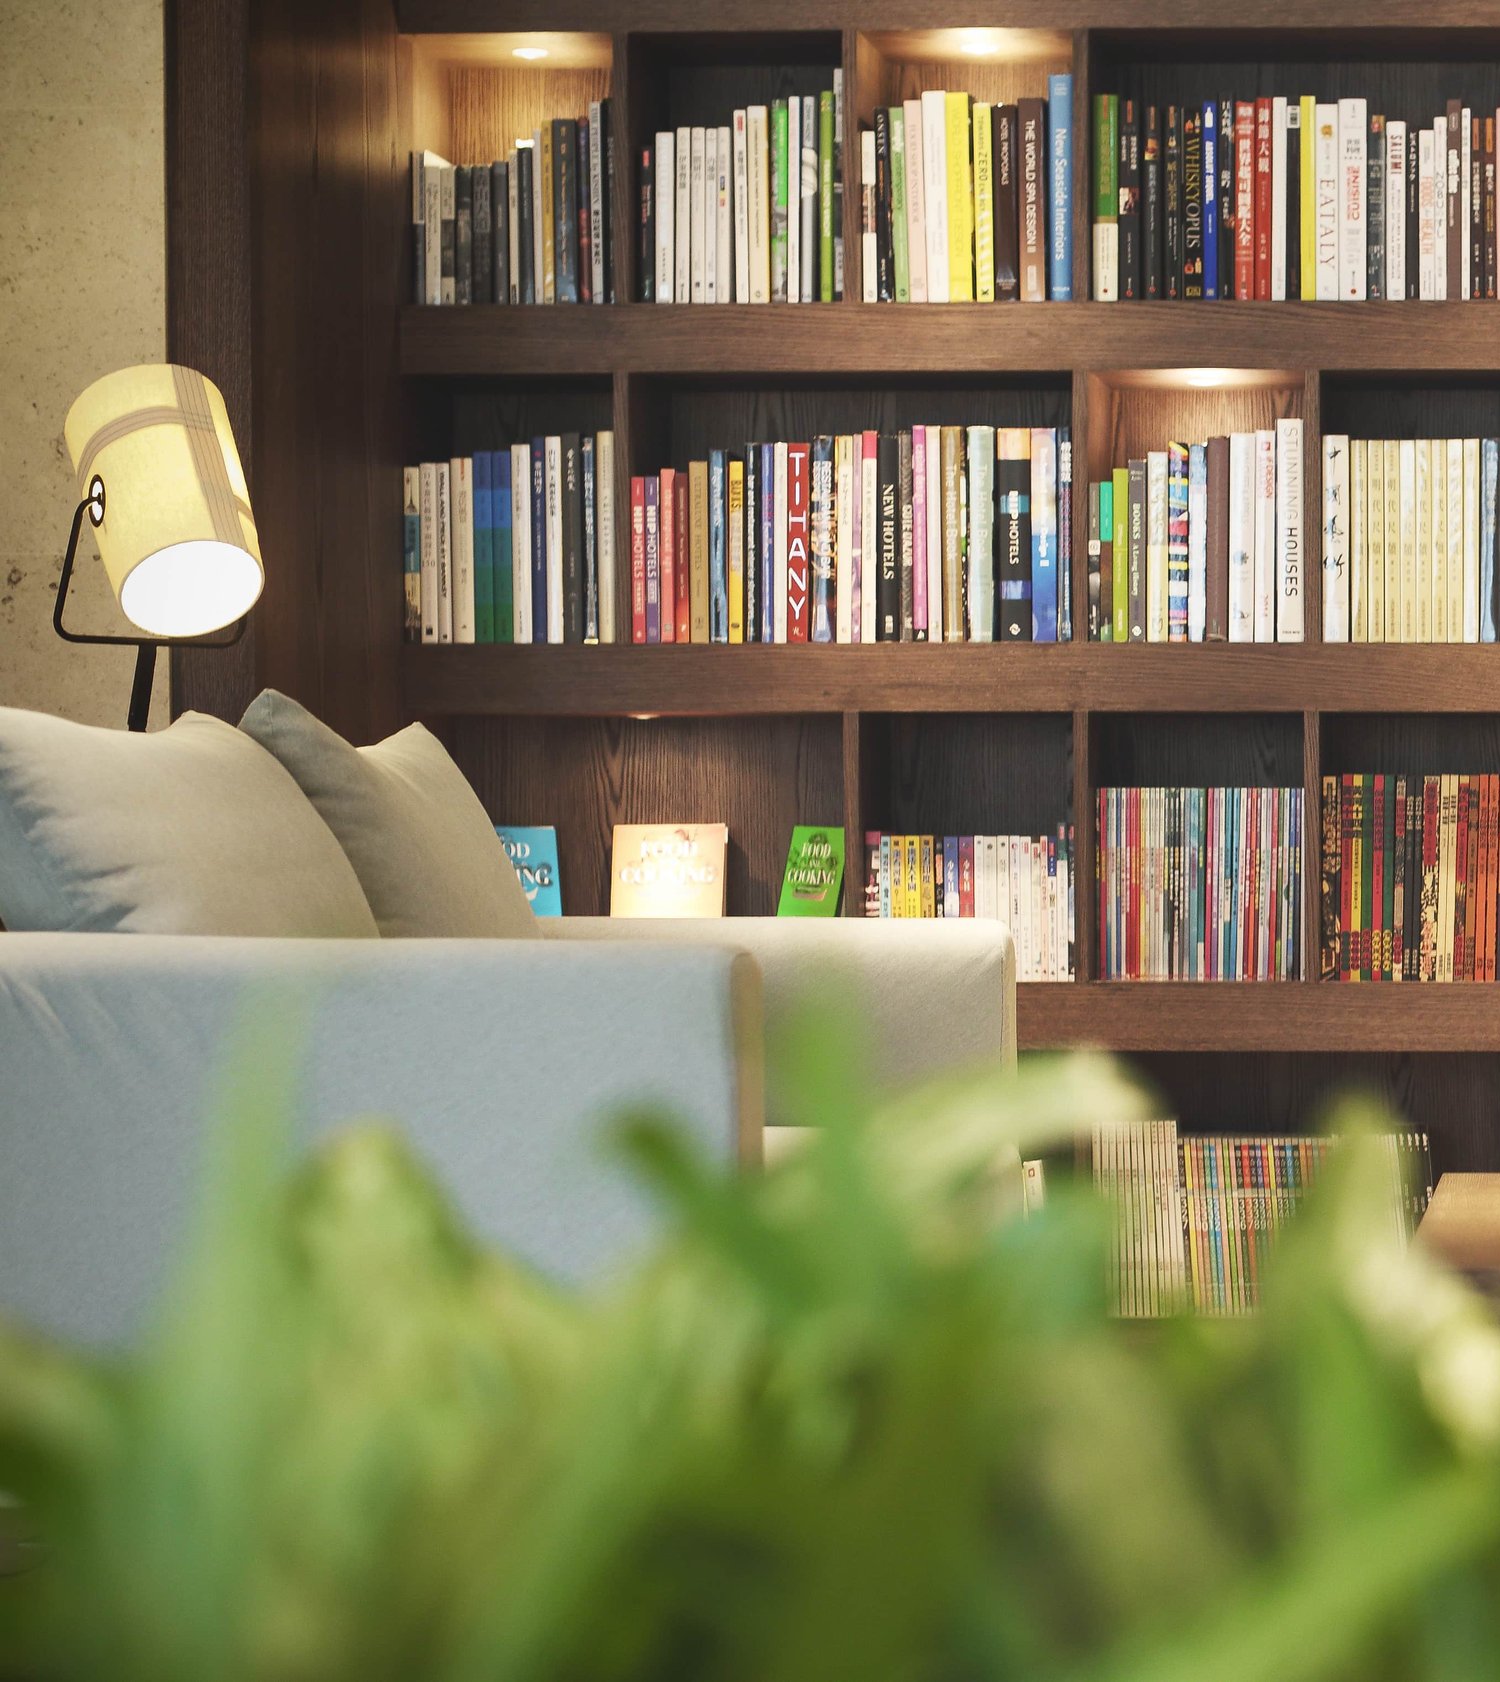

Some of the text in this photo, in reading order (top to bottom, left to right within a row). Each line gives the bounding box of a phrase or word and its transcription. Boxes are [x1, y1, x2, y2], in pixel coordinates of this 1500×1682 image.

[876, 114, 885, 155] ONSEN
[1025, 120, 1036, 141] THE
[978, 152, 988, 182] ZERO
[1000, 118, 1009, 185] HOTEL PROPOSALS
[1025, 143, 1036, 180] WORLD
[1390, 134, 1402, 175] SALUMI
[1026, 182, 1036, 205] SPA
[1054, 128, 1067, 261] New Seaside Interiors
[1352, 167, 1361, 221] CUISINE
[1026, 206, 1036, 245] DESIGN
[1319, 179, 1335, 271] EATALY
[1421, 218, 1433, 256] HEALTH
[1265, 466, 1273, 499] DESIGN
[633, 505, 642, 534] HIP
[647, 505, 656, 534] HIP
[883, 484, 895, 580] NEW HOTELS
[946, 464, 958, 560] The Hotel Book
[976, 465, 988, 560] The Hotel Book
[1132, 503, 1141, 539] BOOKS
[1283, 427, 1298, 597] STUNNING HOUSES
[633, 534, 643, 579] HOTELS
[647, 534, 656, 578] HOTELS
[788, 452, 807, 620] TIHANY
[1009, 520, 1019, 565] HOTELS
[502, 842, 530, 858] OD
[801, 842, 831, 858] FOOD
[788, 868, 836, 885] COOKING
